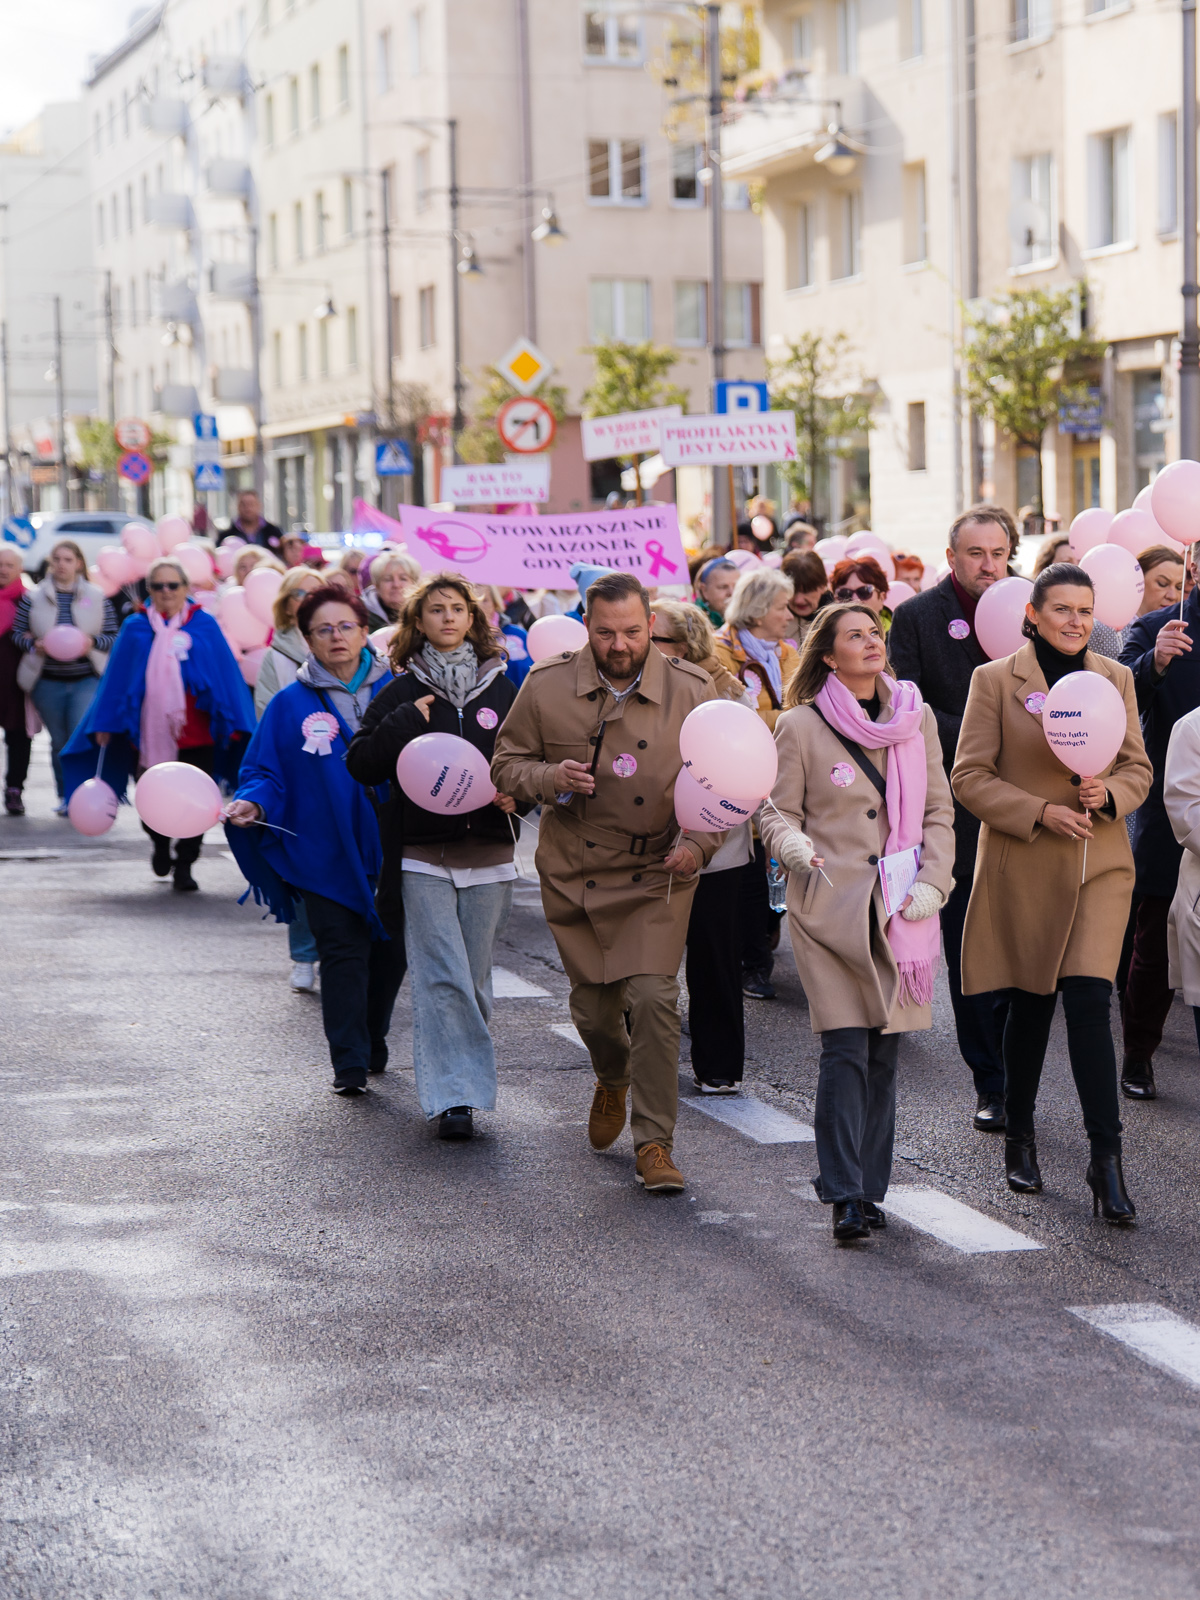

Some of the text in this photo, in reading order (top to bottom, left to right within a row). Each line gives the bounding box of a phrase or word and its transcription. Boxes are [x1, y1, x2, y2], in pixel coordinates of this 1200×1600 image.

[666, 423, 788, 440] PROFILAKTYKA
[679, 442, 712, 456] JEST
[501, 471, 522, 483] TO
[486, 516, 668, 537] STOWARZYSZENIE
[525, 537, 637, 554] AMAZONEK
[522, 554, 643, 570] GDYŃKICH
[1049, 710, 1082, 719] GDYNIA
[430, 765, 450, 798] GDYNIA
